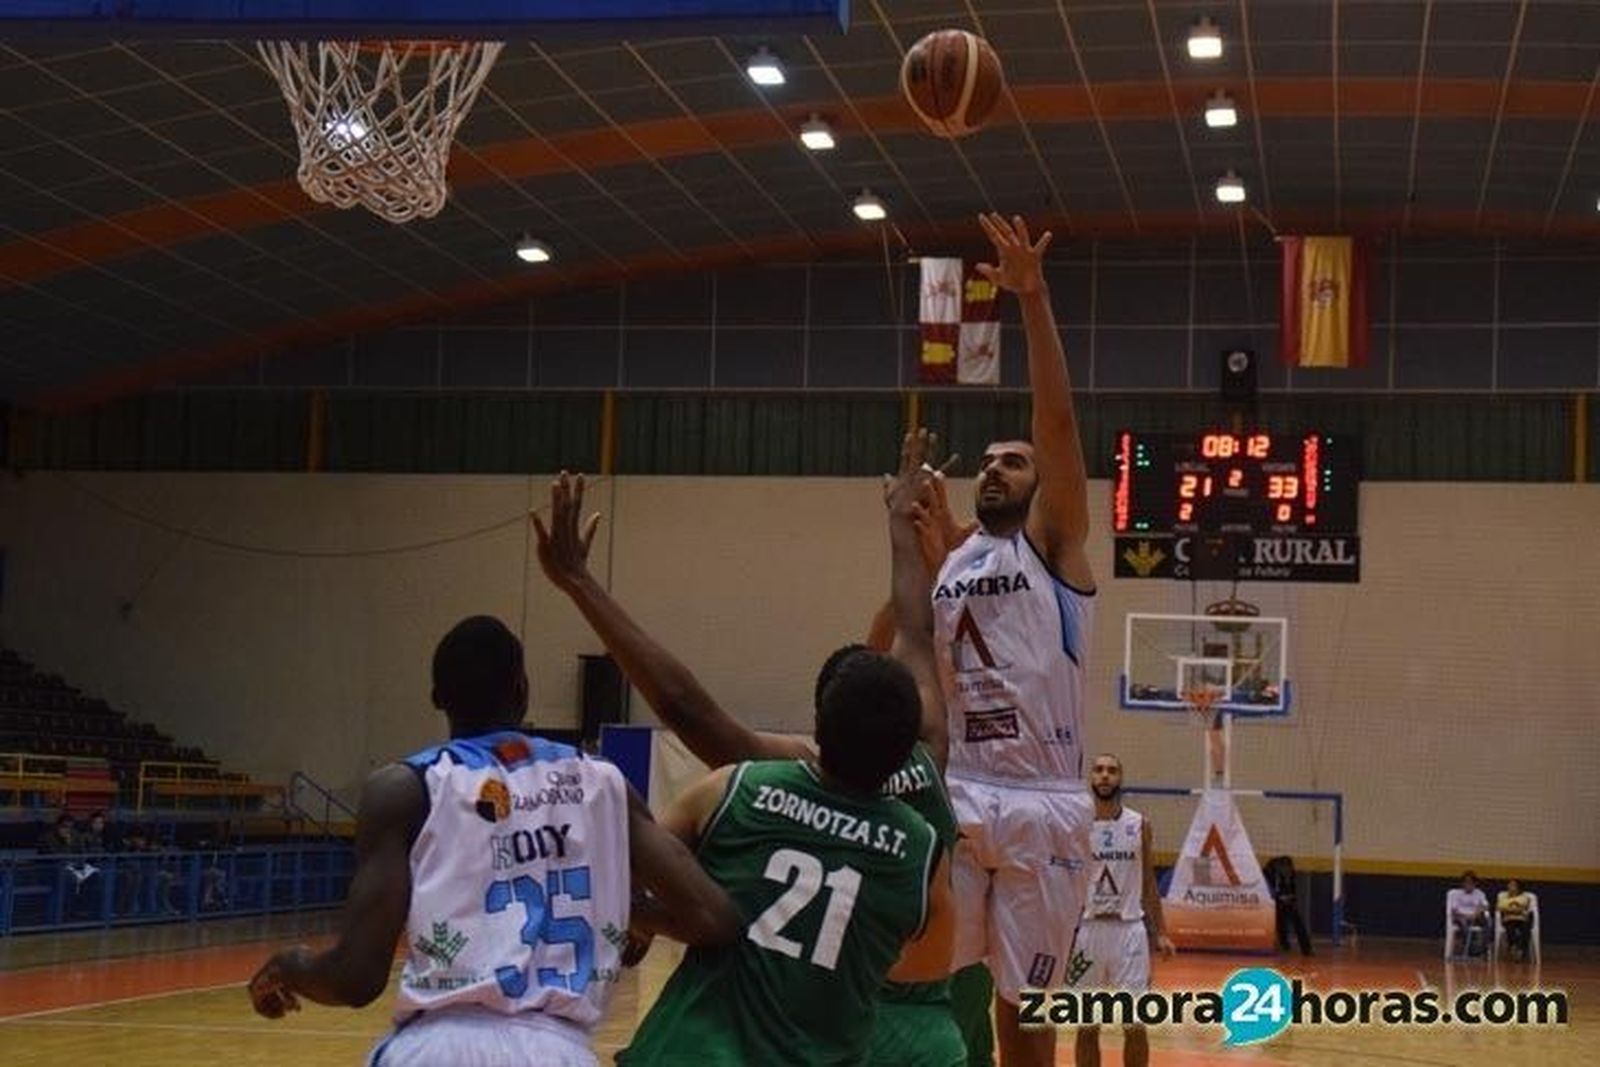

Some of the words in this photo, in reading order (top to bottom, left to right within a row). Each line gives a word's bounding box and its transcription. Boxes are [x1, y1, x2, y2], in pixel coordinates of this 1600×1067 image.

[1202, 435, 1270, 457] 08:12
[1180, 475, 1213, 498] 21
[1228, 469, 1243, 487] 2
[1268, 476, 1299, 499] 33
[1179, 503, 1193, 521] 2
[1277, 504, 1291, 521] 0
[1253, 538, 1356, 565] RURAL
[933, 571, 1031, 600] AMORA
[752, 785, 871, 845] ZORNOTZA
[873, 824, 908, 859] S.T.
[1102, 830, 1114, 847] 2
[747, 848, 862, 970] 21
[485, 865, 594, 1000] 35
